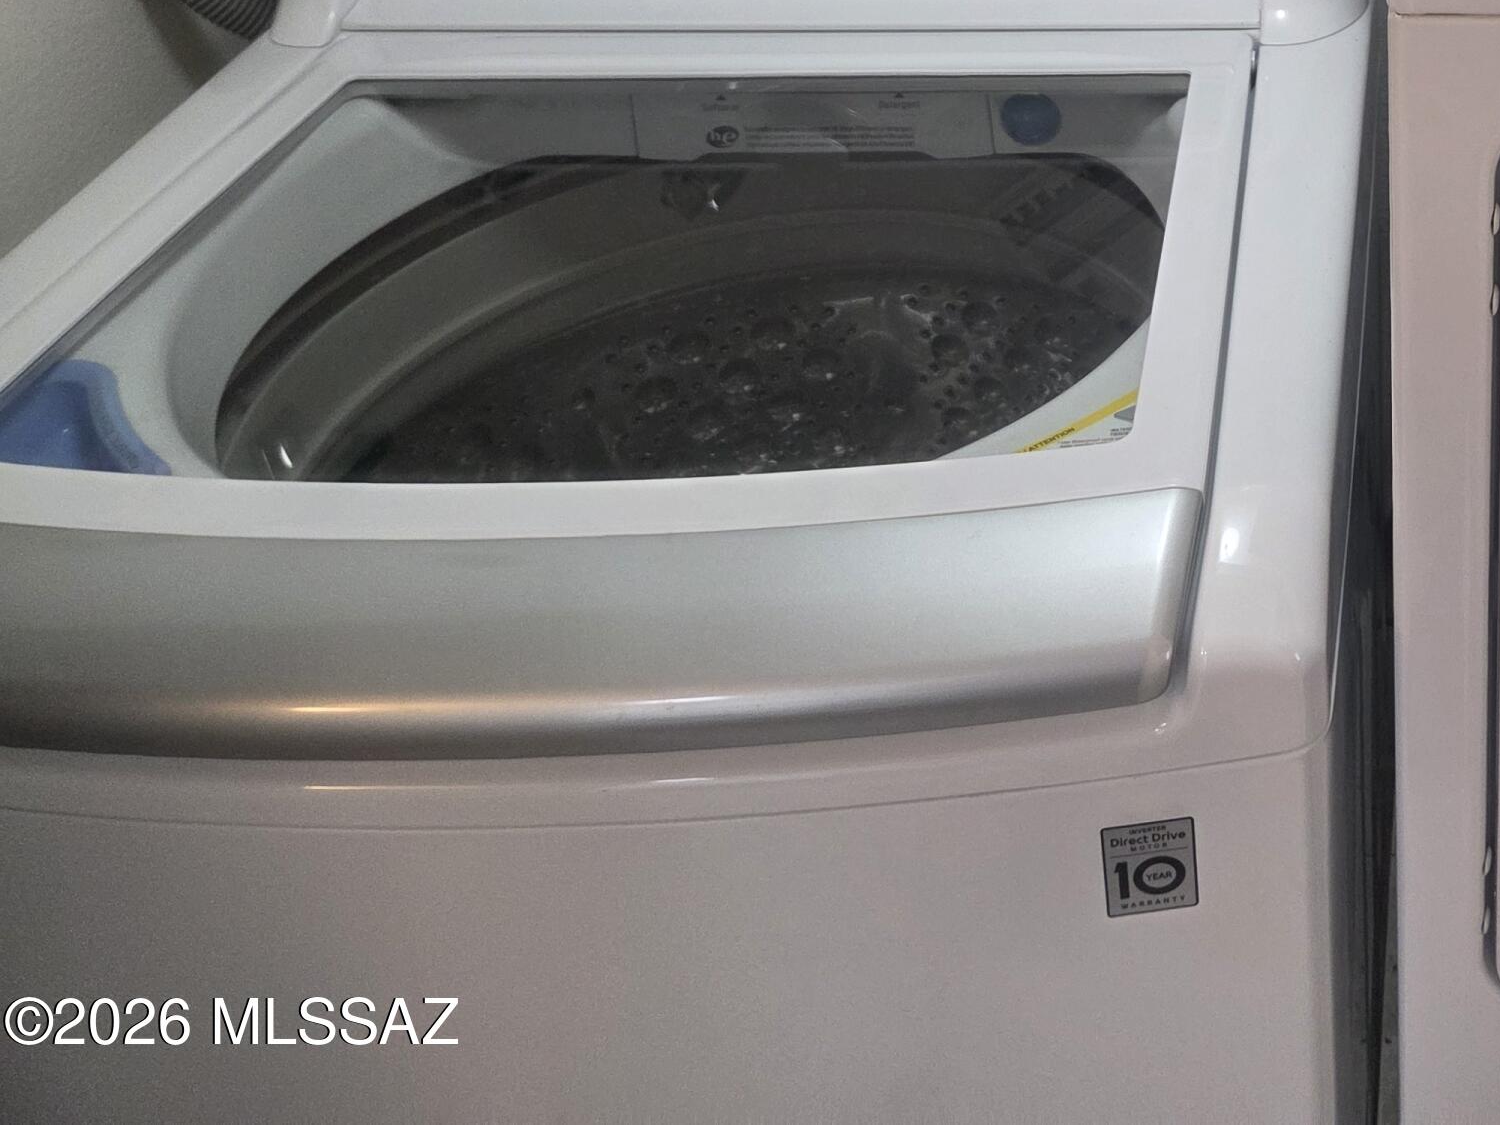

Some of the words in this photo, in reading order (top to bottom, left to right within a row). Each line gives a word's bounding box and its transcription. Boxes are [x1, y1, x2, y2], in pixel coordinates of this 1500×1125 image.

[1029, 427, 1075, 452] ATTENTION
[1111, 835, 1149, 848] Direct
[1152, 831, 1186, 842] Drive
[1130, 843, 1168, 852] MOTOR
[1114, 856, 1186, 901] 10
[1146, 870, 1173, 881] YEAR
[1121, 895, 1186, 909] WARRANTY
